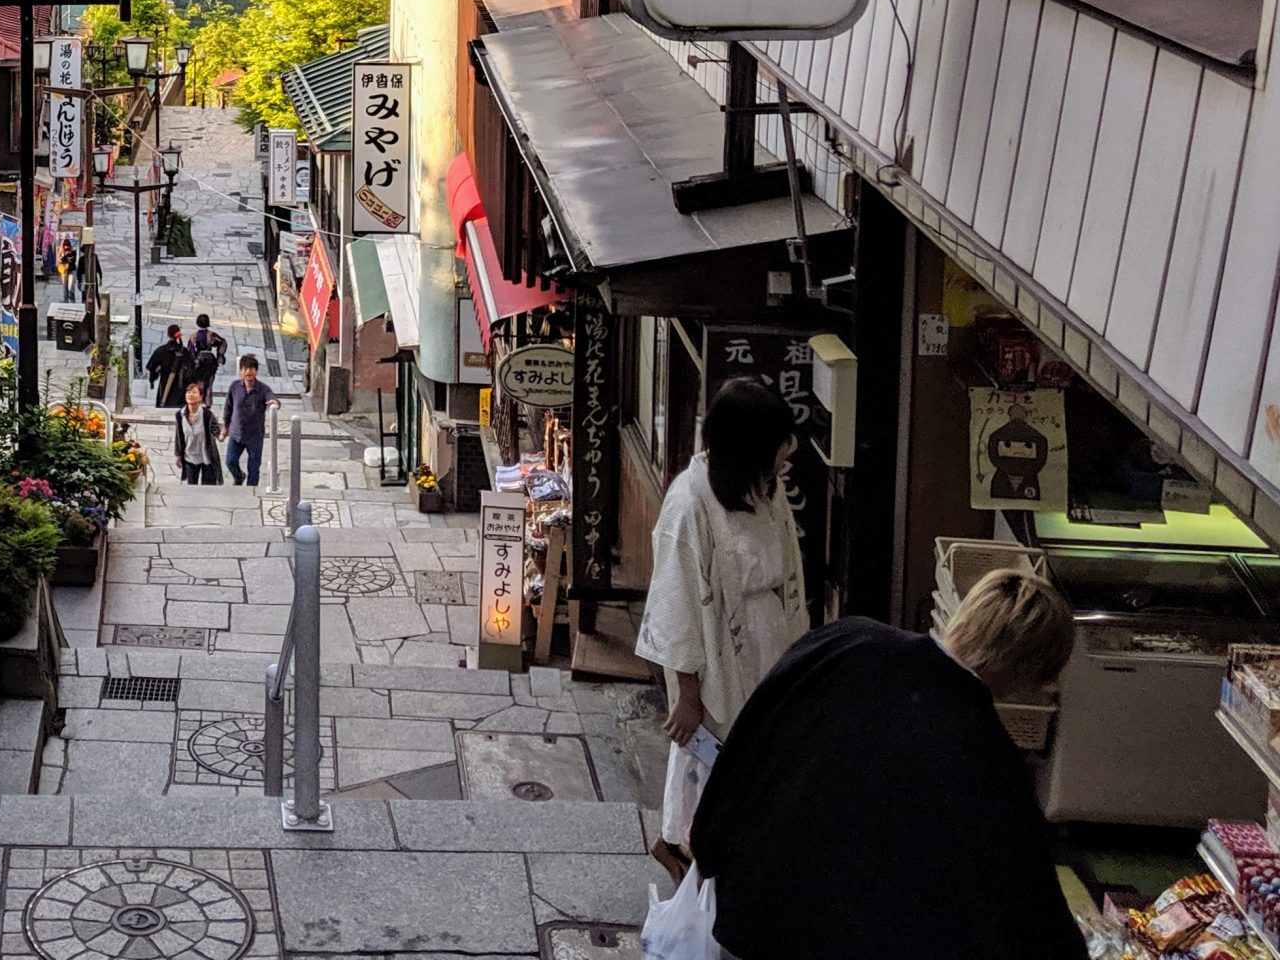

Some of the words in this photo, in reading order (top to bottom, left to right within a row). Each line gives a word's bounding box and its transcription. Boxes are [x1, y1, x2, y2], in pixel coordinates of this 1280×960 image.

[361, 72, 404, 89] 伊香保
[363, 93, 402, 188] みやげ
[485, 522, 521, 534] おみやげ
[493, 542, 513, 633] すみよしや
